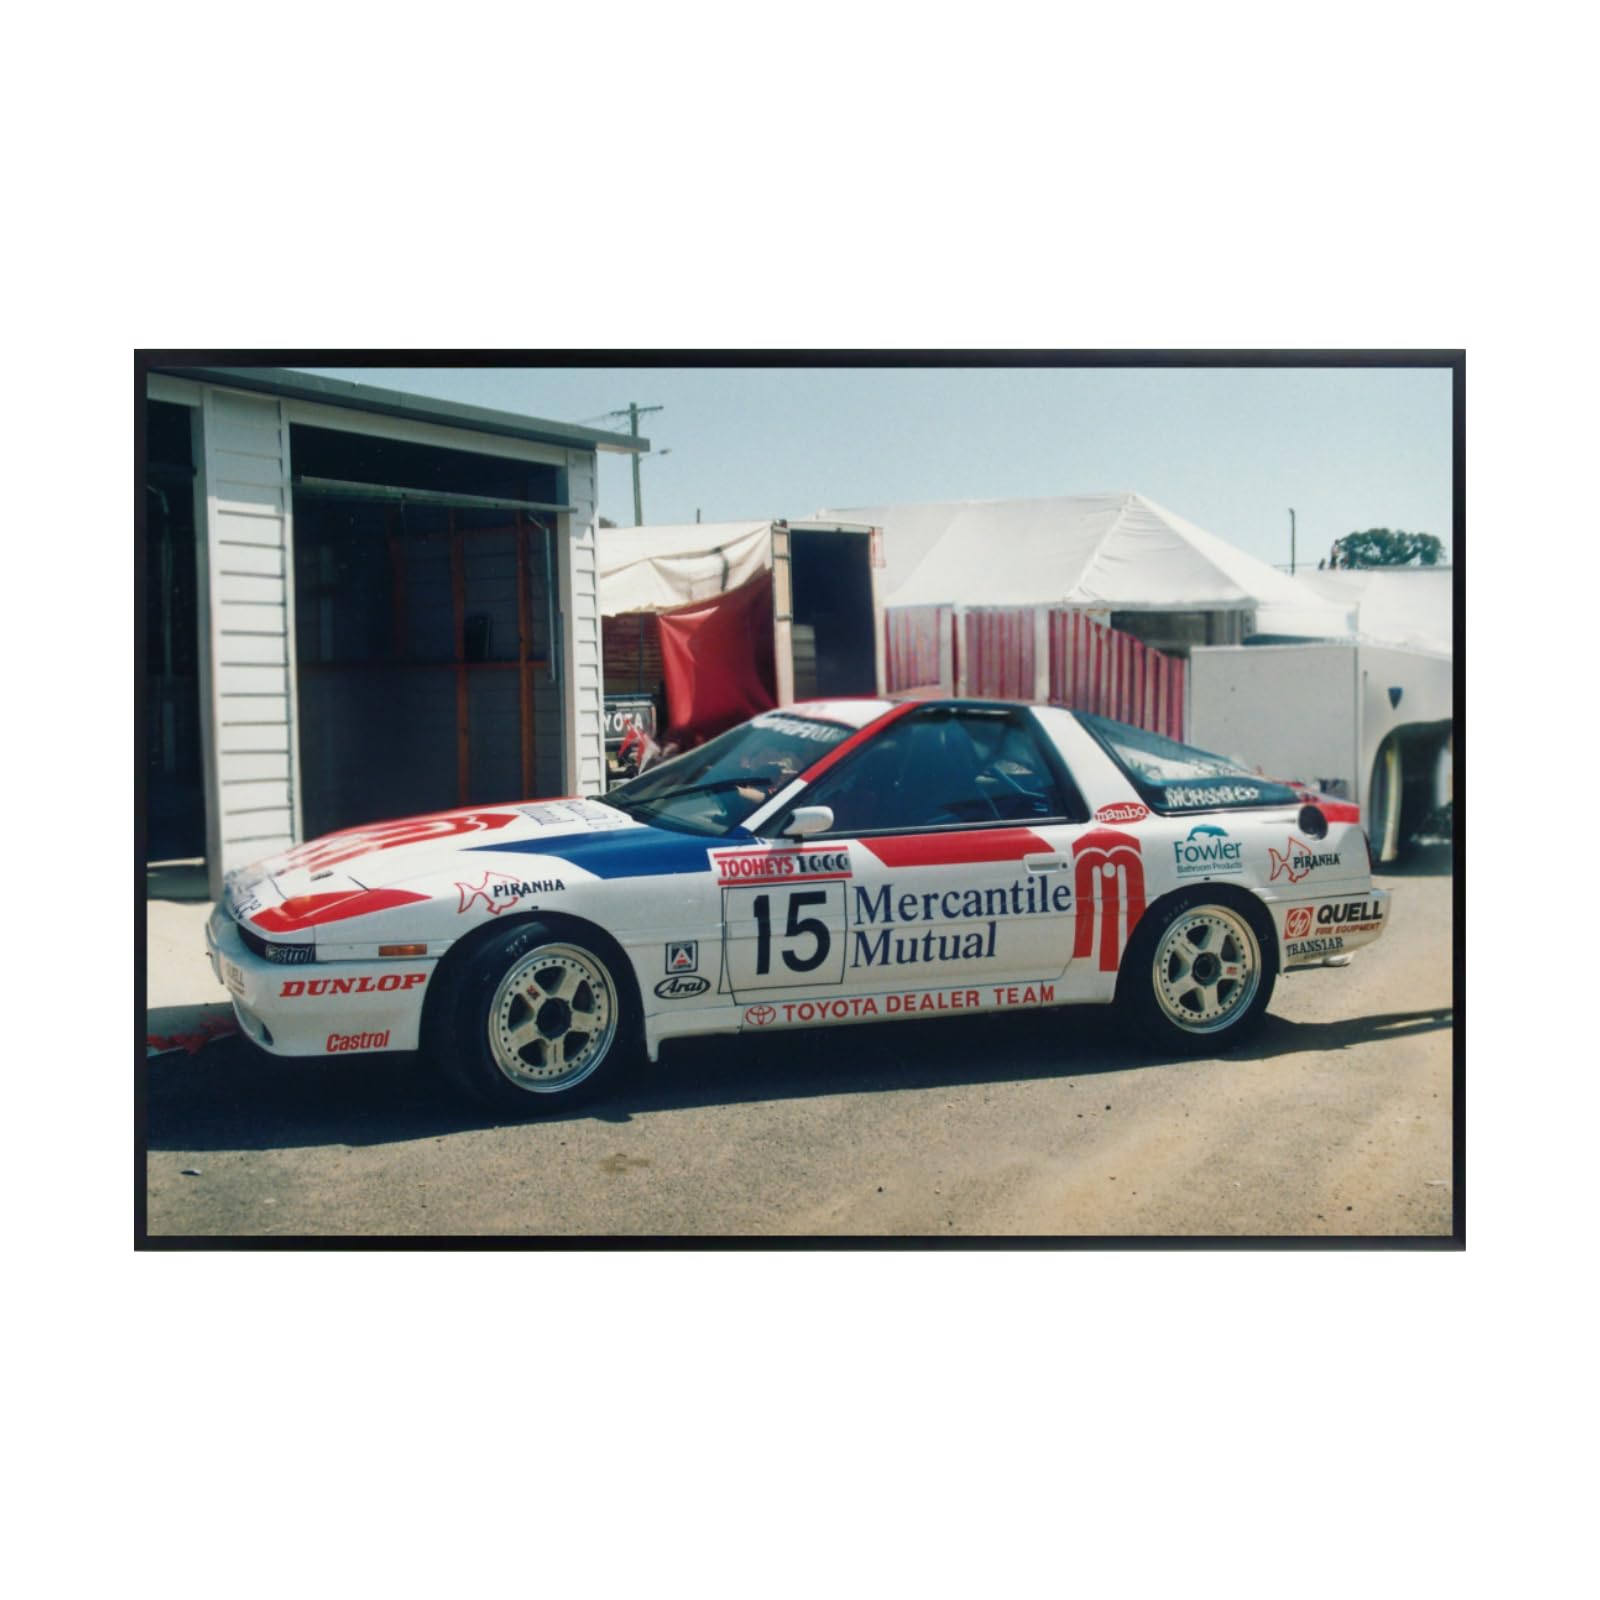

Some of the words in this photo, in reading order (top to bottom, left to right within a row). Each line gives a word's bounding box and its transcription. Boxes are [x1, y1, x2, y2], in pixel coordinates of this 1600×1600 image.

[1095, 804, 1147, 822] mambo
[1174, 838, 1243, 864] Fowler
[1292, 853, 1341, 870] PIRANHA
[717, 856, 794, 878] TOOHEYS
[796, 854, 849, 873] 1000
[493, 879, 566, 898] PIRANHA
[851, 875, 1072, 926] Mercantile
[1316, 901, 1383, 924] QUELL
[753, 890, 831, 975] 15
[1335, 922, 1381, 934] EQUIPMENT
[850, 921, 997, 968] Mutual
[279, 973, 427, 998] DUNLOP
[658, 978, 704, 993] Arai
[782, 997, 878, 1022] TOYOTA
[886, 990, 980, 1013] DEALER
[993, 985, 1055, 1006] TEAM
[326, 1029, 391, 1053] Castrol
